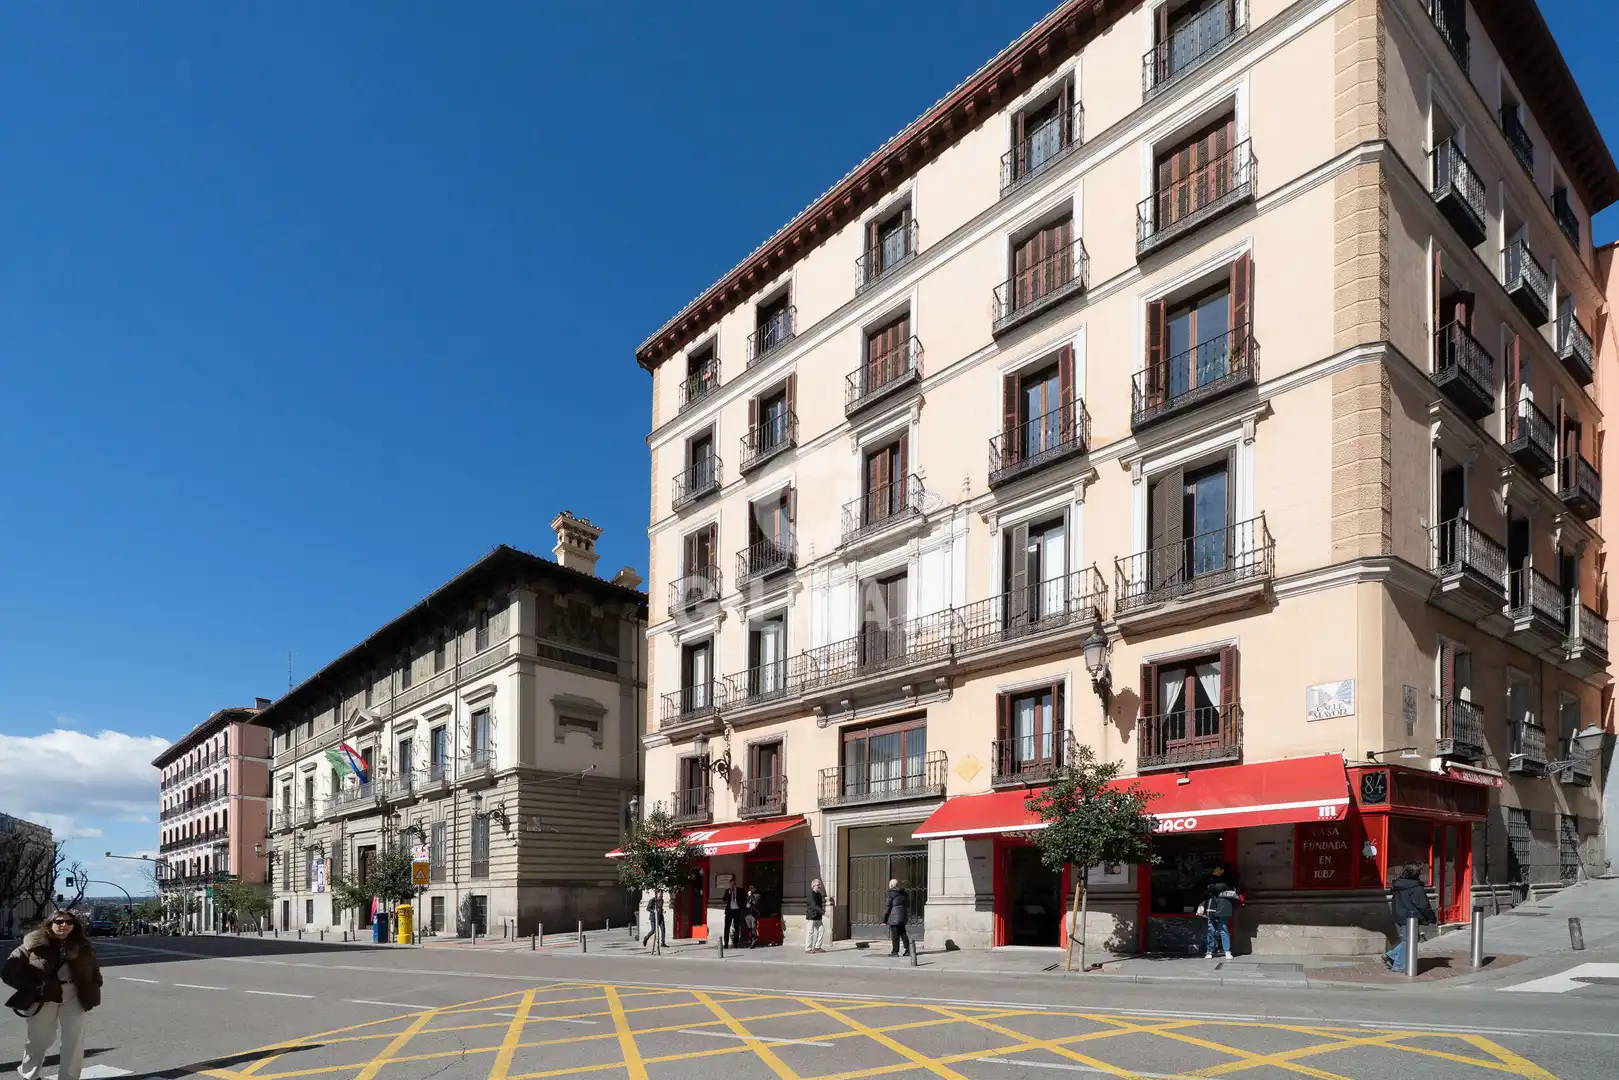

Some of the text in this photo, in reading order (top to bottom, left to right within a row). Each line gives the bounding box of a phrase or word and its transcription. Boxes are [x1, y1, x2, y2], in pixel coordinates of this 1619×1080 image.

[1313, 708, 1348, 719] MAYOR
[1365, 774, 1384, 794] 84
[886, 836, 894, 844] 84
[1303, 840, 1348, 851] FUNDADA
[1318, 855, 1332, 865] EN
